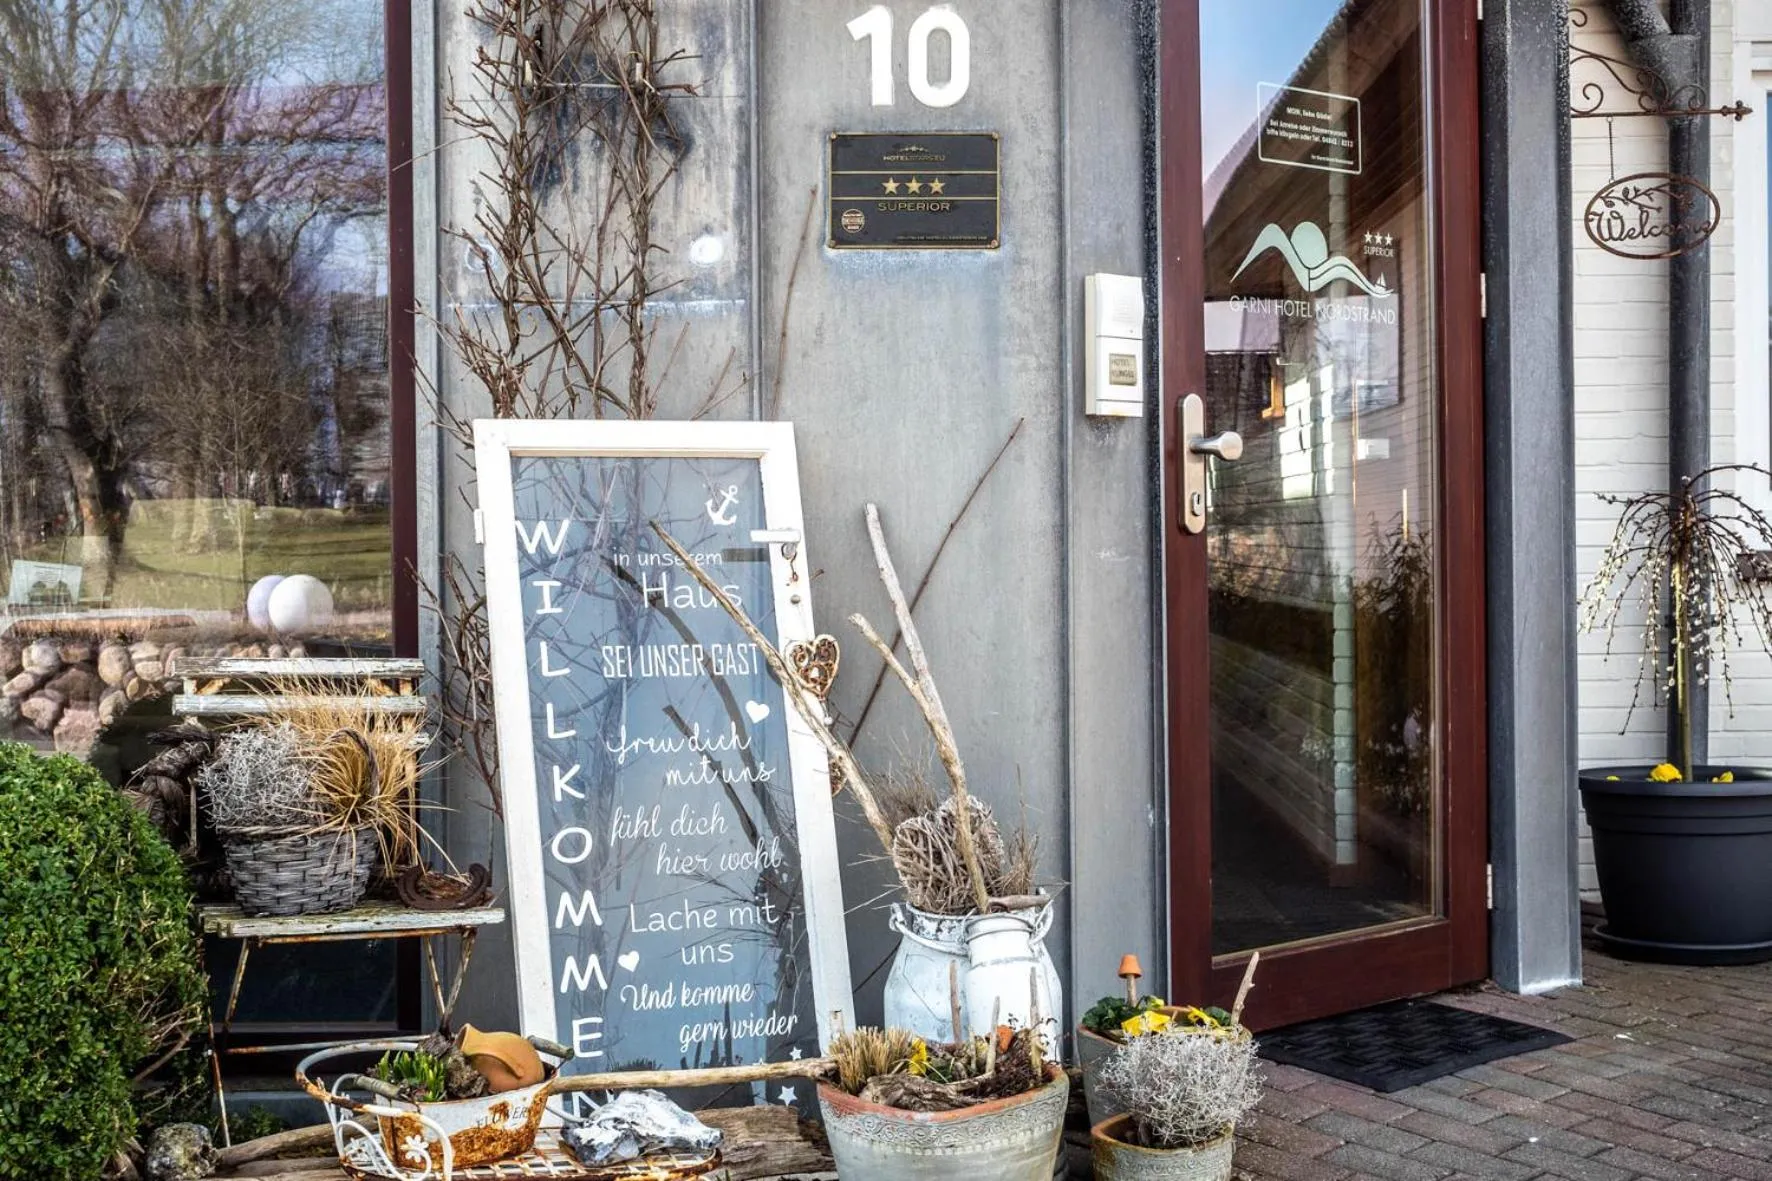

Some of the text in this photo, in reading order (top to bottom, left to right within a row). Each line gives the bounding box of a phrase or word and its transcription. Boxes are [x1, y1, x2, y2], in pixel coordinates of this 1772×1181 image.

[846, 4, 971, 108] 10
[878, 202, 951, 213] SUPERIOR
[1363, 244, 1394, 258] SUPERIOR
[1229, 294, 1396, 326] GARNI HOTEL NORDSTRAND
[613, 546, 630, 567] in
[641, 571, 743, 609] Haus
[602, 642, 759, 679] SEI UNSER GAST
[606, 720, 752, 765] freu dich
[665, 754, 776, 786] mit uns
[610, 801, 729, 847] fühl dich
[656, 835, 782, 876] hier wohl
[630, 897, 780, 933] Lache mit
[681, 942, 735, 966] uns
[619, 980, 756, 1012] Und komme
[678, 1013, 799, 1054] gern wieder
